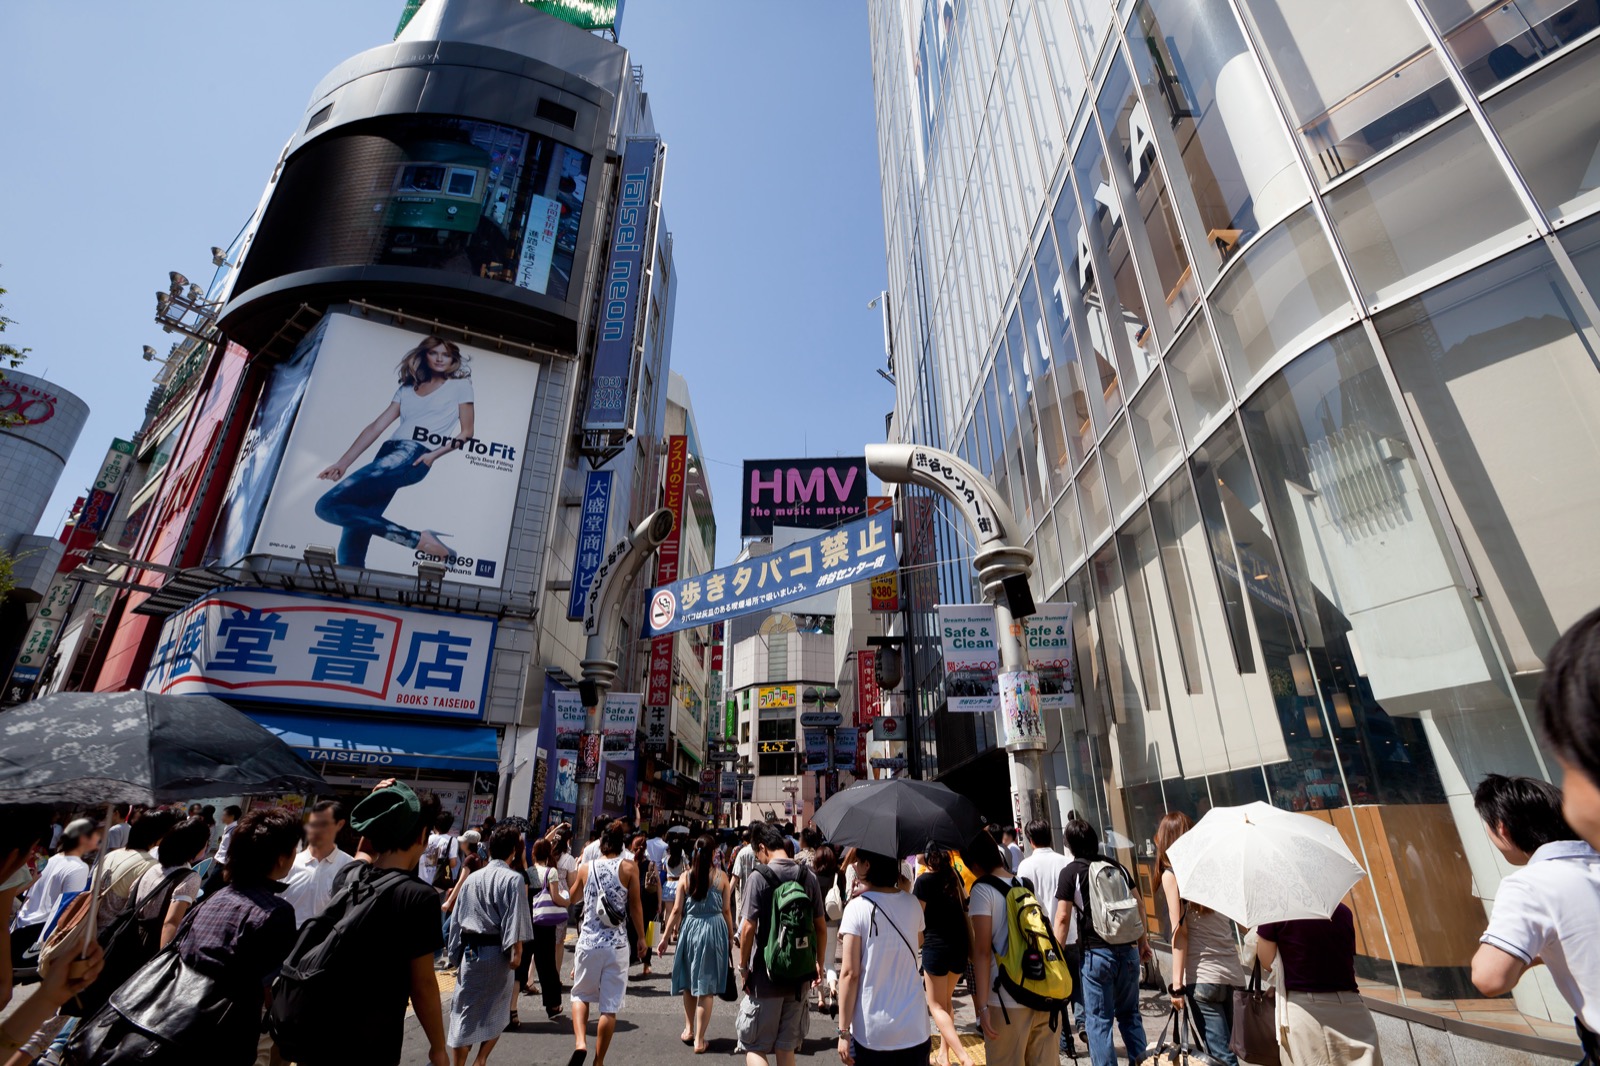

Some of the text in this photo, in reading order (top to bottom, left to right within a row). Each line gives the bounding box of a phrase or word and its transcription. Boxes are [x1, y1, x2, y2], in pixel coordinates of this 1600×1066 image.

[603, 167, 650, 341] Taisei neon
[598, 376, 622, 387] (03)
[595, 388, 622, 399] 3719
[593, 399, 621, 410] 2468
[470, 460, 495, 469] Premium
[482, 457, 496, 465] Best
[751, 465, 858, 505] HMV
[916, 453, 993, 533] 渋谷センター街
[750, 505, 860, 517] the music master
[443, 554, 474, 567] 1969
[680, 519, 887, 612] 歩きタバコ禁止
[815, 554, 887, 588] 渋谷センター街
[584, 541, 626, 632] 渋谷センター街
[944, 626, 989, 638] Safe &
[1025, 625, 1065, 636] Safe &
[953, 638, 994, 649] Clean
[1029, 636, 1067, 647] Clean
[146, 607, 473, 694] 大盛堂書店
[1028, 658, 1070, 669] ジャニ∞
[652, 643, 669, 704] 七輪焼肉
[396, 694, 476, 711] BOOKS TAISEIDO
[558, 705, 577, 713] Safe
[563, 713, 587, 721] Clean
[610, 714, 635, 722] Clean
[649, 706, 665, 738] 牛繁
[307, 750, 394, 765] TAISEIDO
[605, 777, 618, 795] BOSS
